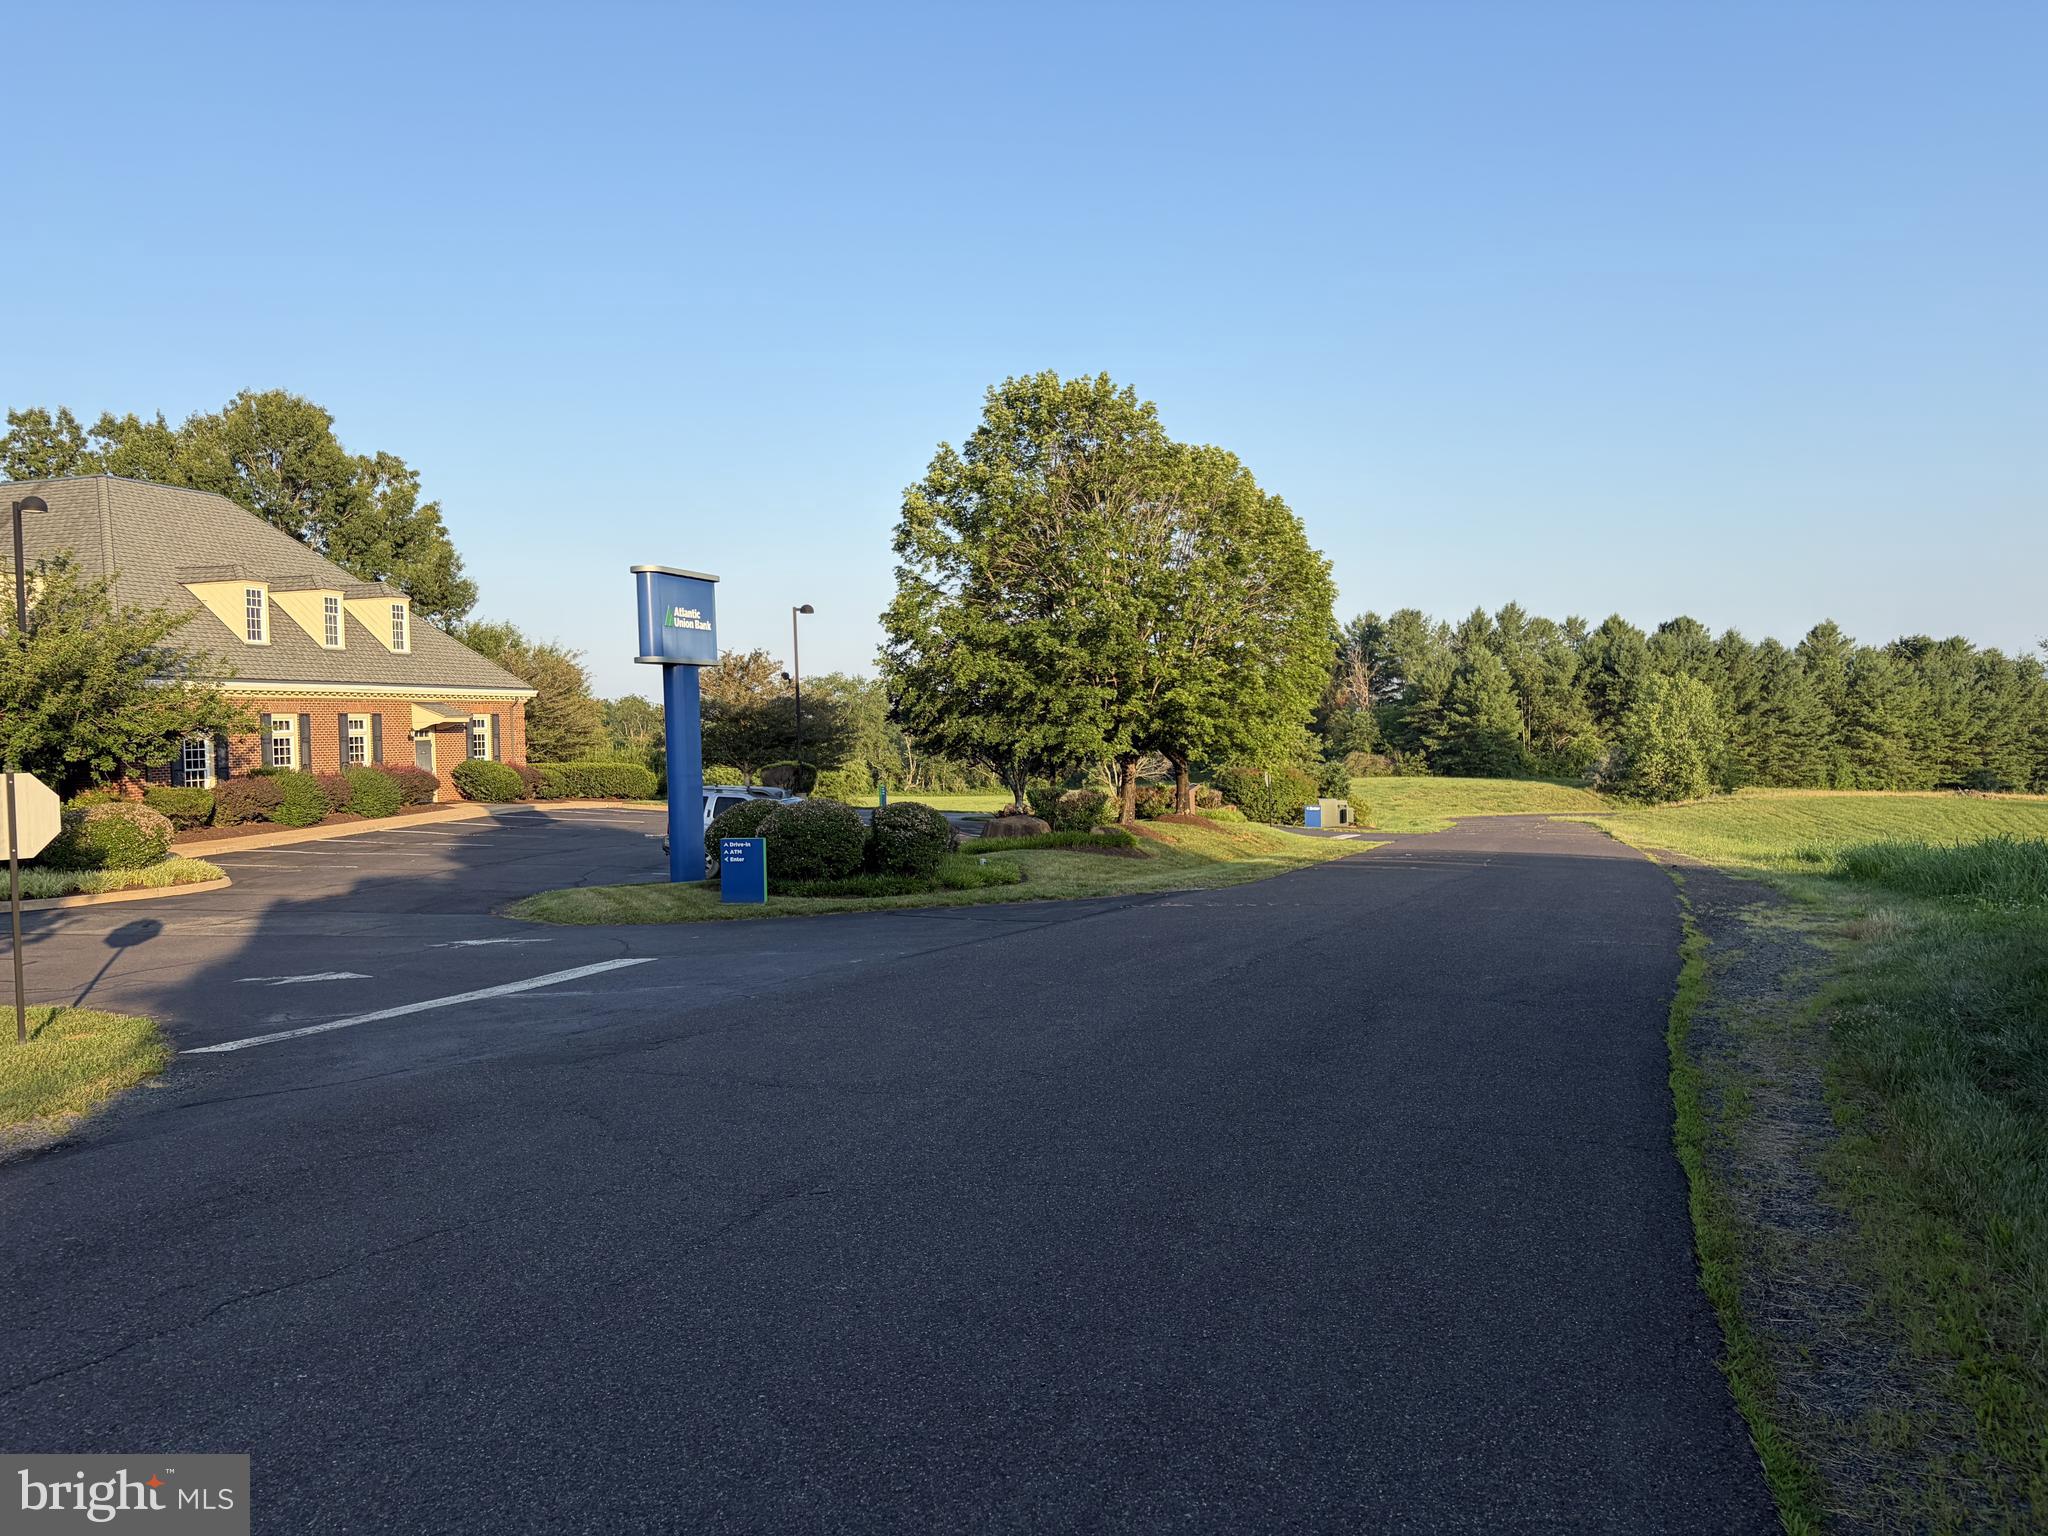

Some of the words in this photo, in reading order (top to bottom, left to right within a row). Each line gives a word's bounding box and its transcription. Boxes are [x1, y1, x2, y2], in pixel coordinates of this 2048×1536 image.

[673, 606, 701, 619] Atlantic
[673, 617, 694, 629] Union
[694, 619, 712, 631] Bank
